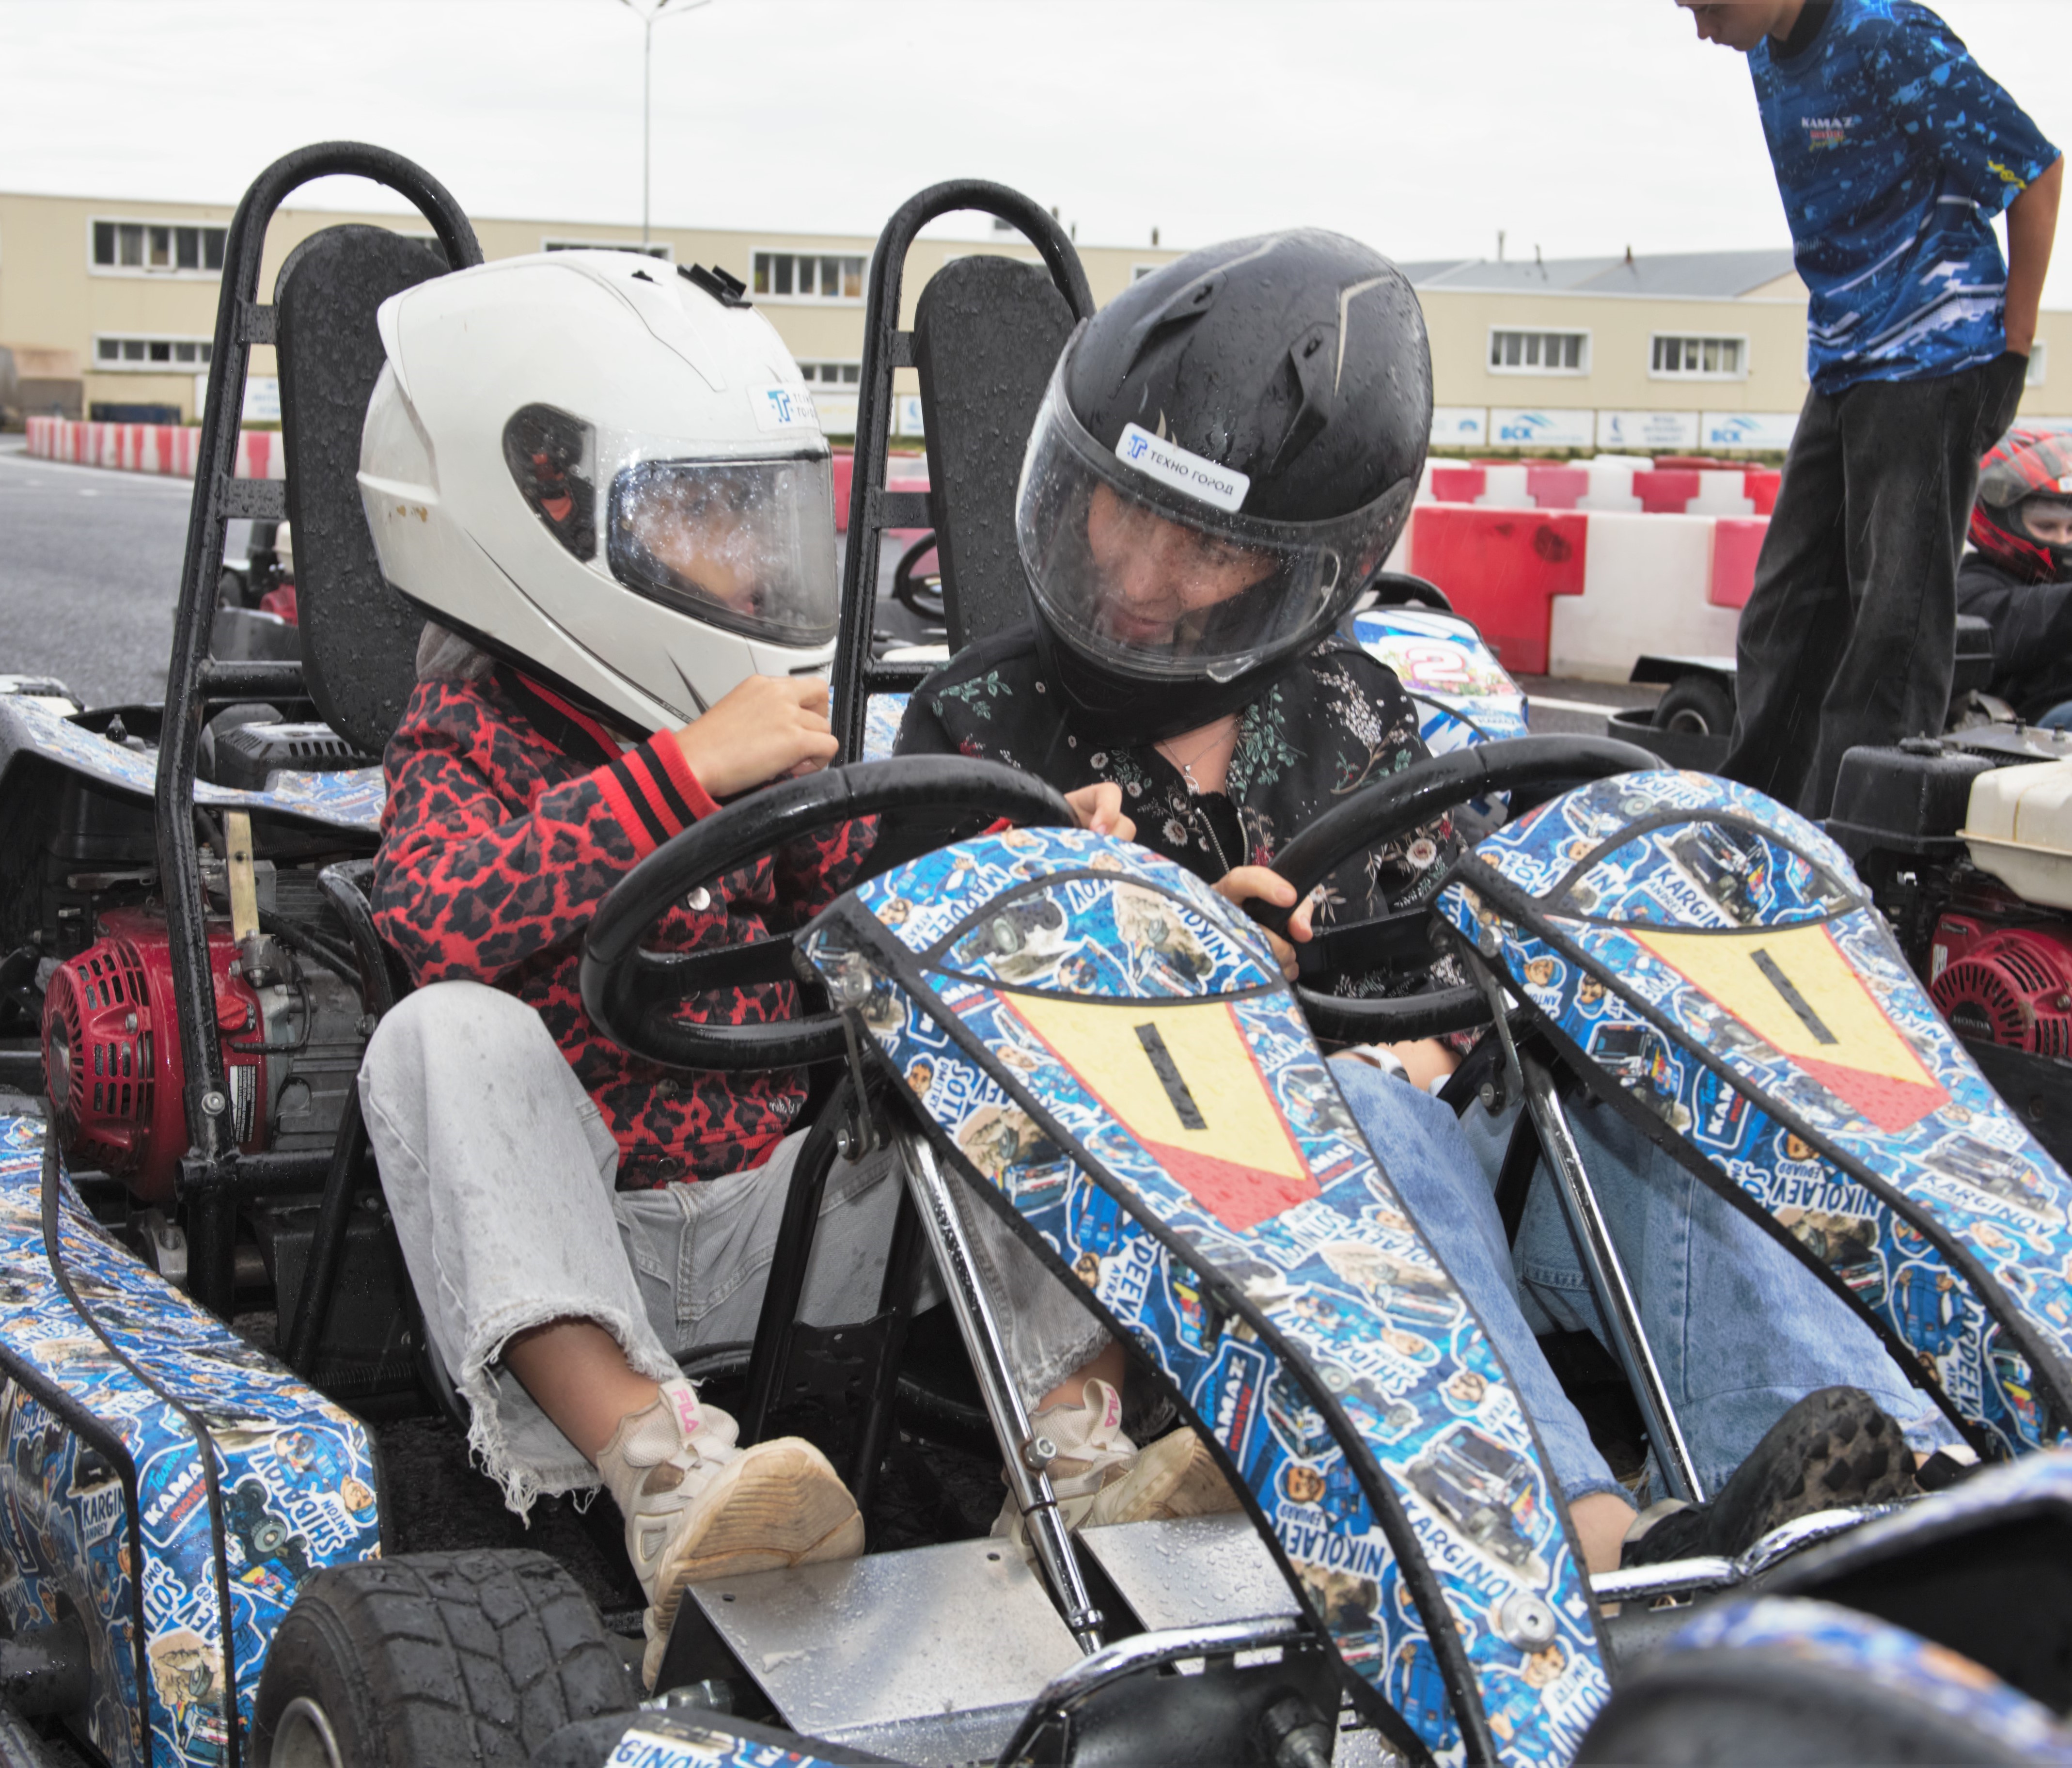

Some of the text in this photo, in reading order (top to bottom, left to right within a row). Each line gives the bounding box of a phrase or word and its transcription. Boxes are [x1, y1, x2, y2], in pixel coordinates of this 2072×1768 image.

[1802, 117, 1854, 129] KAMAZ
[1151, 450, 1234, 496] ТЕХНО ГОРОД
[1405, 647, 1474, 684] 2
[1749, 948, 1840, 1044] 1
[1952, 1014, 1990, 1029] HONDA
[927, 1061, 949, 1109] DMITRY
[1134, 1022, 1209, 1131] 1
[1778, 1163, 1821, 1178] EDUARD
[1771, 1179, 1879, 1218] NIKOLAEV
[1925, 1173, 2054, 1237] KARGINOV
[672, 1388, 699, 1433] FILA
[1105, 1387, 1119, 1427] FILA
[321, 1499, 353, 1536] ANTON
